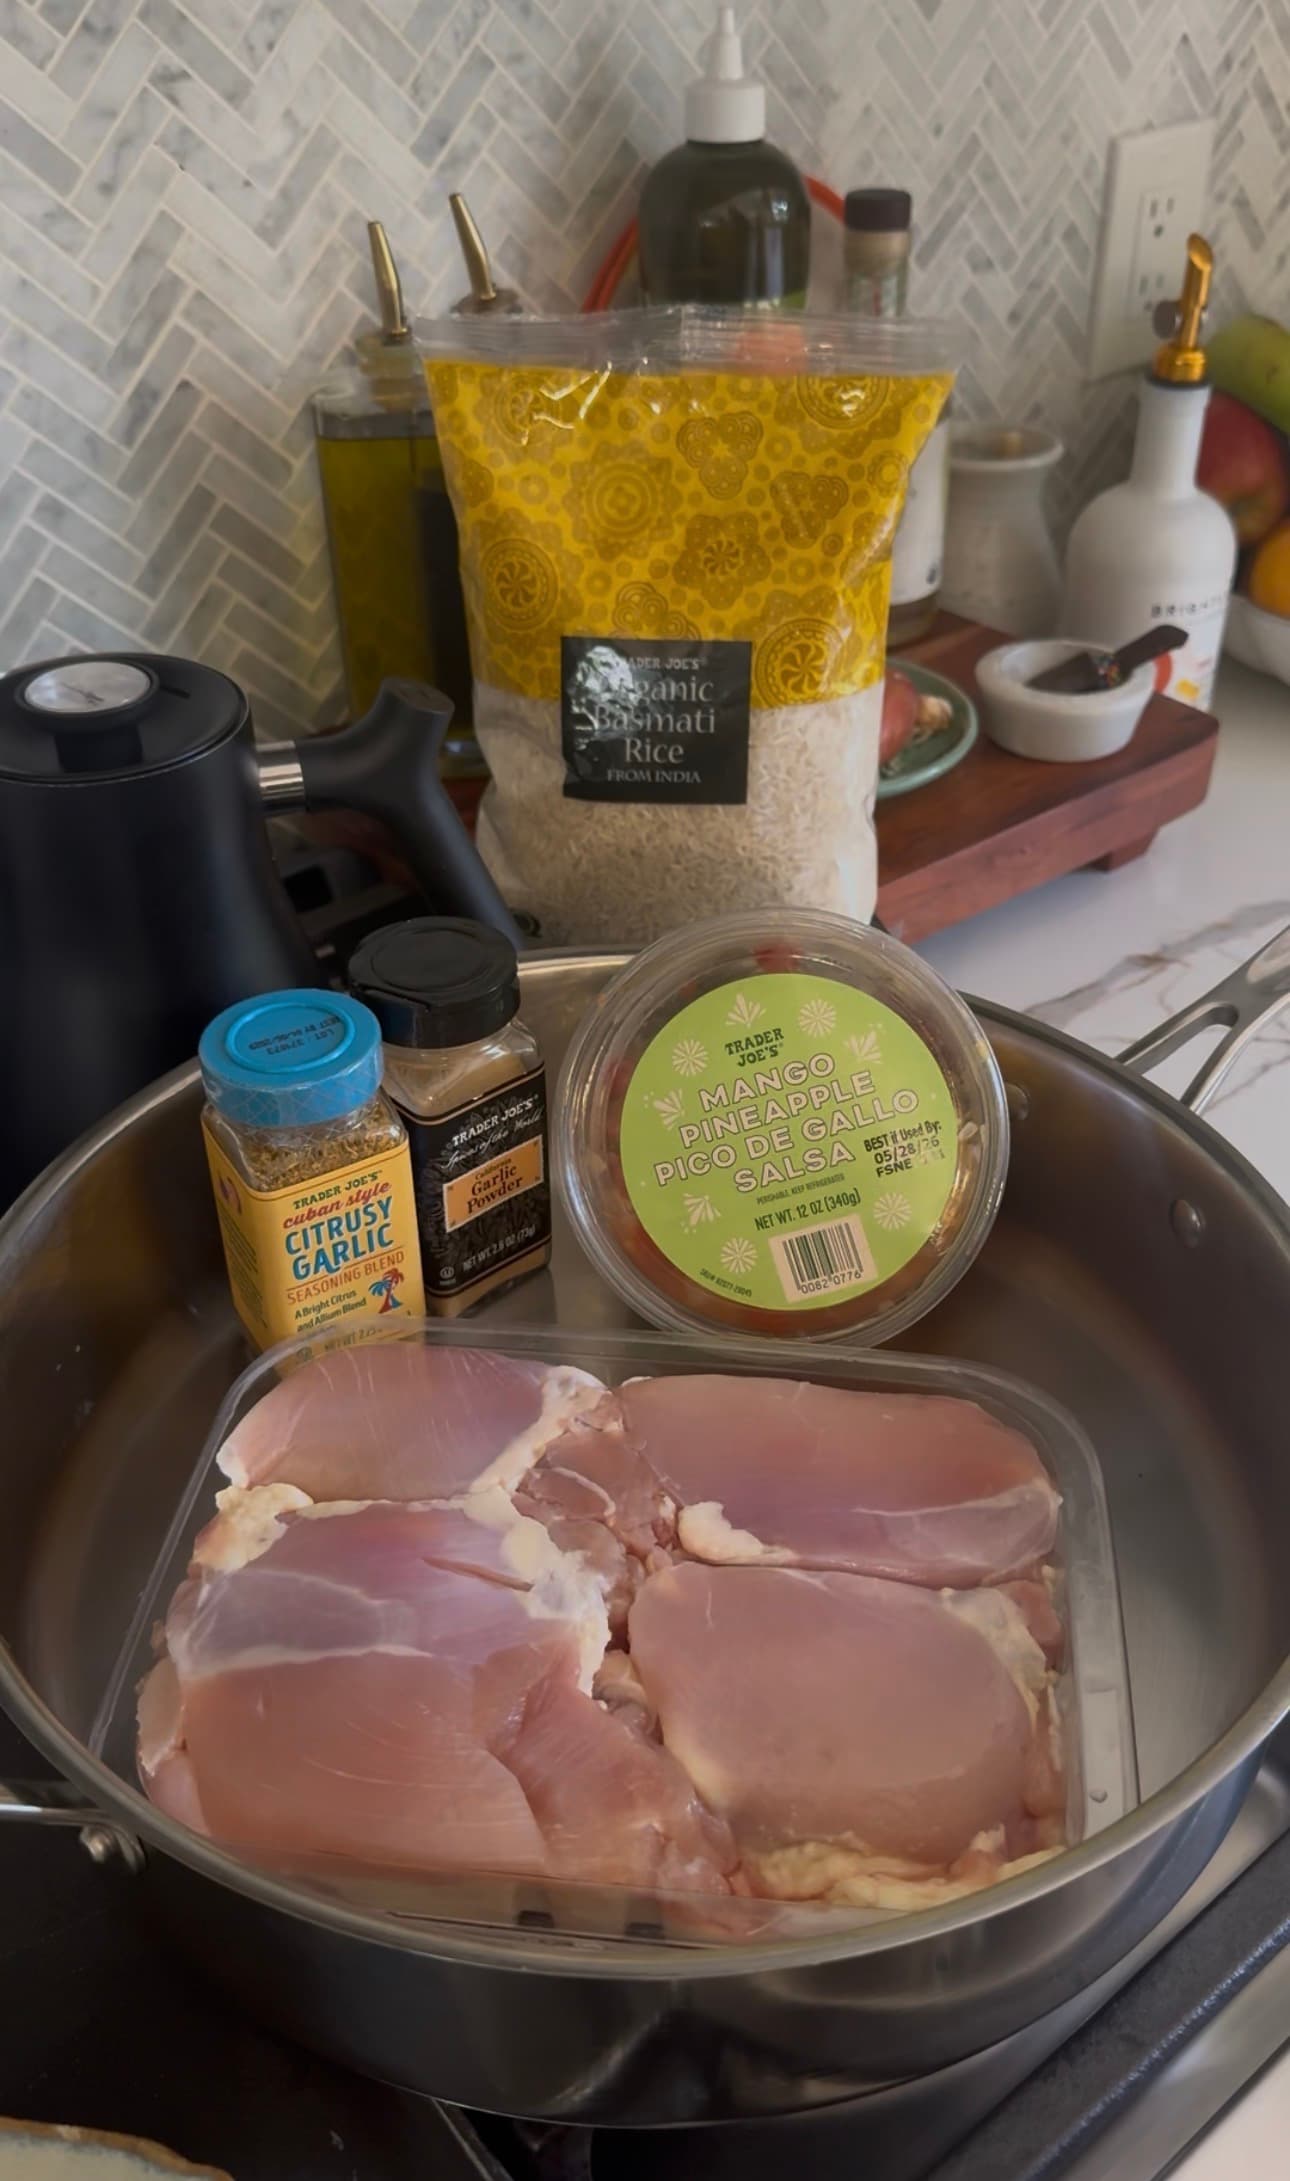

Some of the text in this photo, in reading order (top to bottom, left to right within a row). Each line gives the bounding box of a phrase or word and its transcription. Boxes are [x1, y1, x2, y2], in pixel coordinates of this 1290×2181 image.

[664, 656, 699, 670] JOE'S
[635, 675, 714, 705] ganic
[594, 703, 716, 734] Basmati
[624, 737, 684, 764] Rice
[607, 768, 701, 783] FROM INDIA
[724, 1028, 785, 1067] TRADER JOE'S
[698, 1053, 835, 1112] MANGO
[452, 1098, 534, 1147] TRADER JOE'S
[678, 1070, 876, 1148] PINEAPPLE
[653, 1088, 920, 1186] PICO DE GALLO
[863, 1134, 889, 1152] BEST
[889, 1130, 899, 1145] if
[899, 1122, 923, 1142] Used
[471, 1166, 517, 1196] Garlic
[732, 1141, 856, 1193] SALSA
[876, 1158, 913, 1178] FSNE
[283, 1181, 392, 1229] cuban style
[293, 1174, 379, 1210] TRADER JOE'S
[467, 1177, 523, 1214] Powder
[754, 1187, 862, 1231] NET WT. 12 OZ (340g)
[285, 1195, 393, 1256] CITRUSY
[292, 1222, 394, 1280] GARLIC
[463, 1255, 476, 1272] NET
[286, 1266, 362, 1306] SEASONING
[364, 1250, 405, 1276] BLEND
[801, 1270, 862, 1294] 0082 0776
[294, 1290, 357, 1320] A Bright Citrus
[297, 1297, 367, 1333] and Allium Blend
